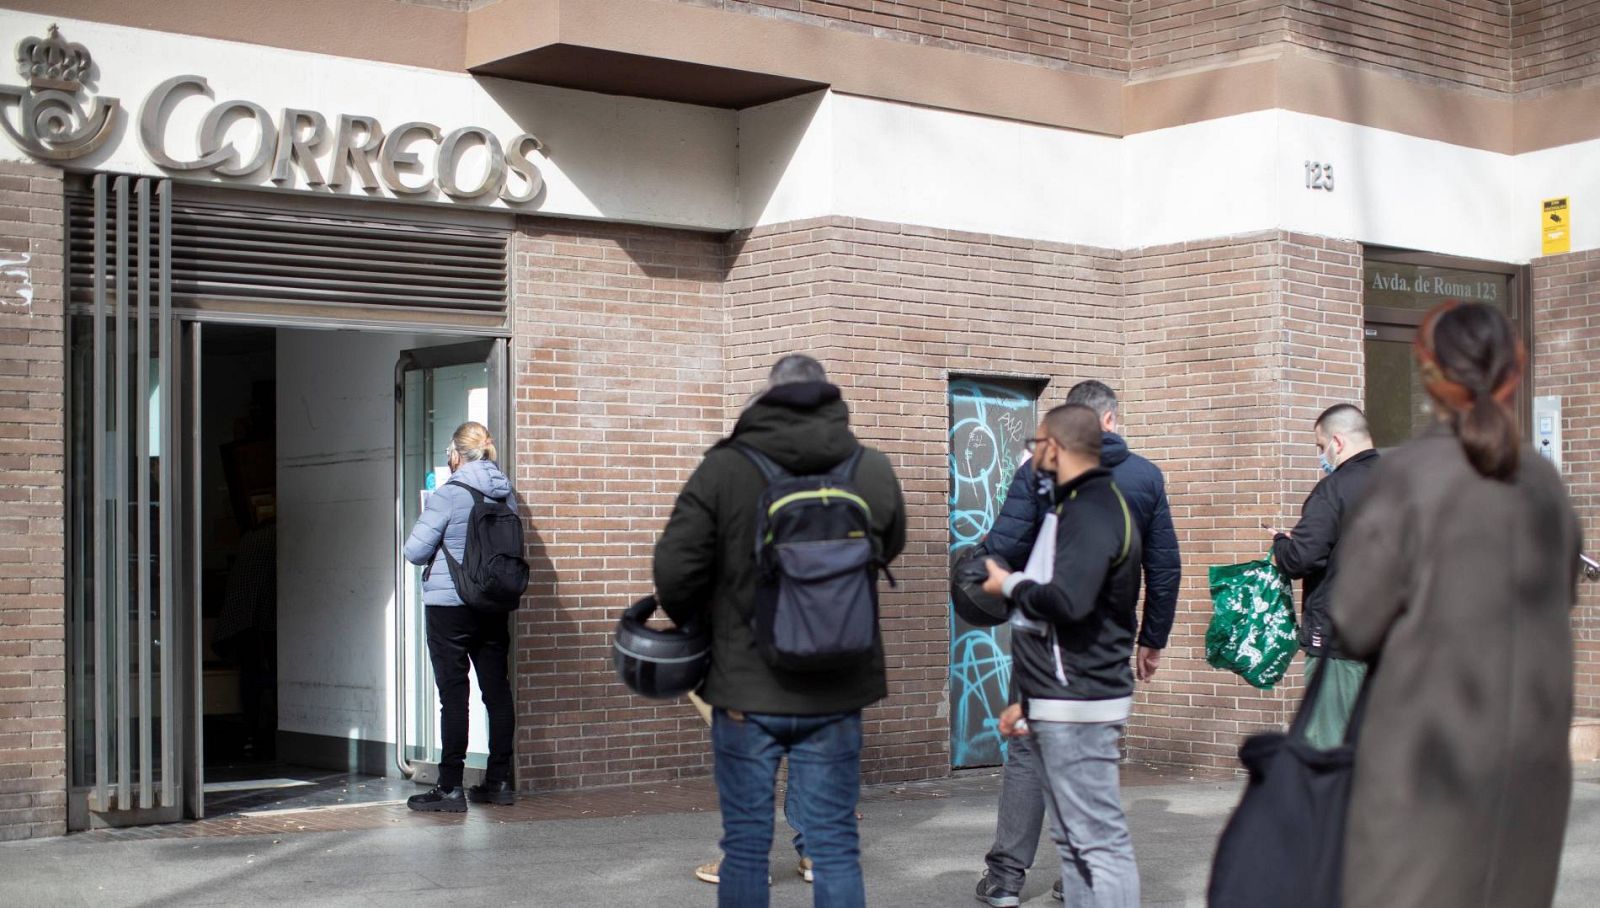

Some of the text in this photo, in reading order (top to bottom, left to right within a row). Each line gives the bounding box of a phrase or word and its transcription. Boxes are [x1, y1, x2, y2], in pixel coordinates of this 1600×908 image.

[140, 74, 546, 203] CORREOS
[1304, 160, 1334, 192] 123
[1372, 272, 1497, 300] Avda. de Roma 123
